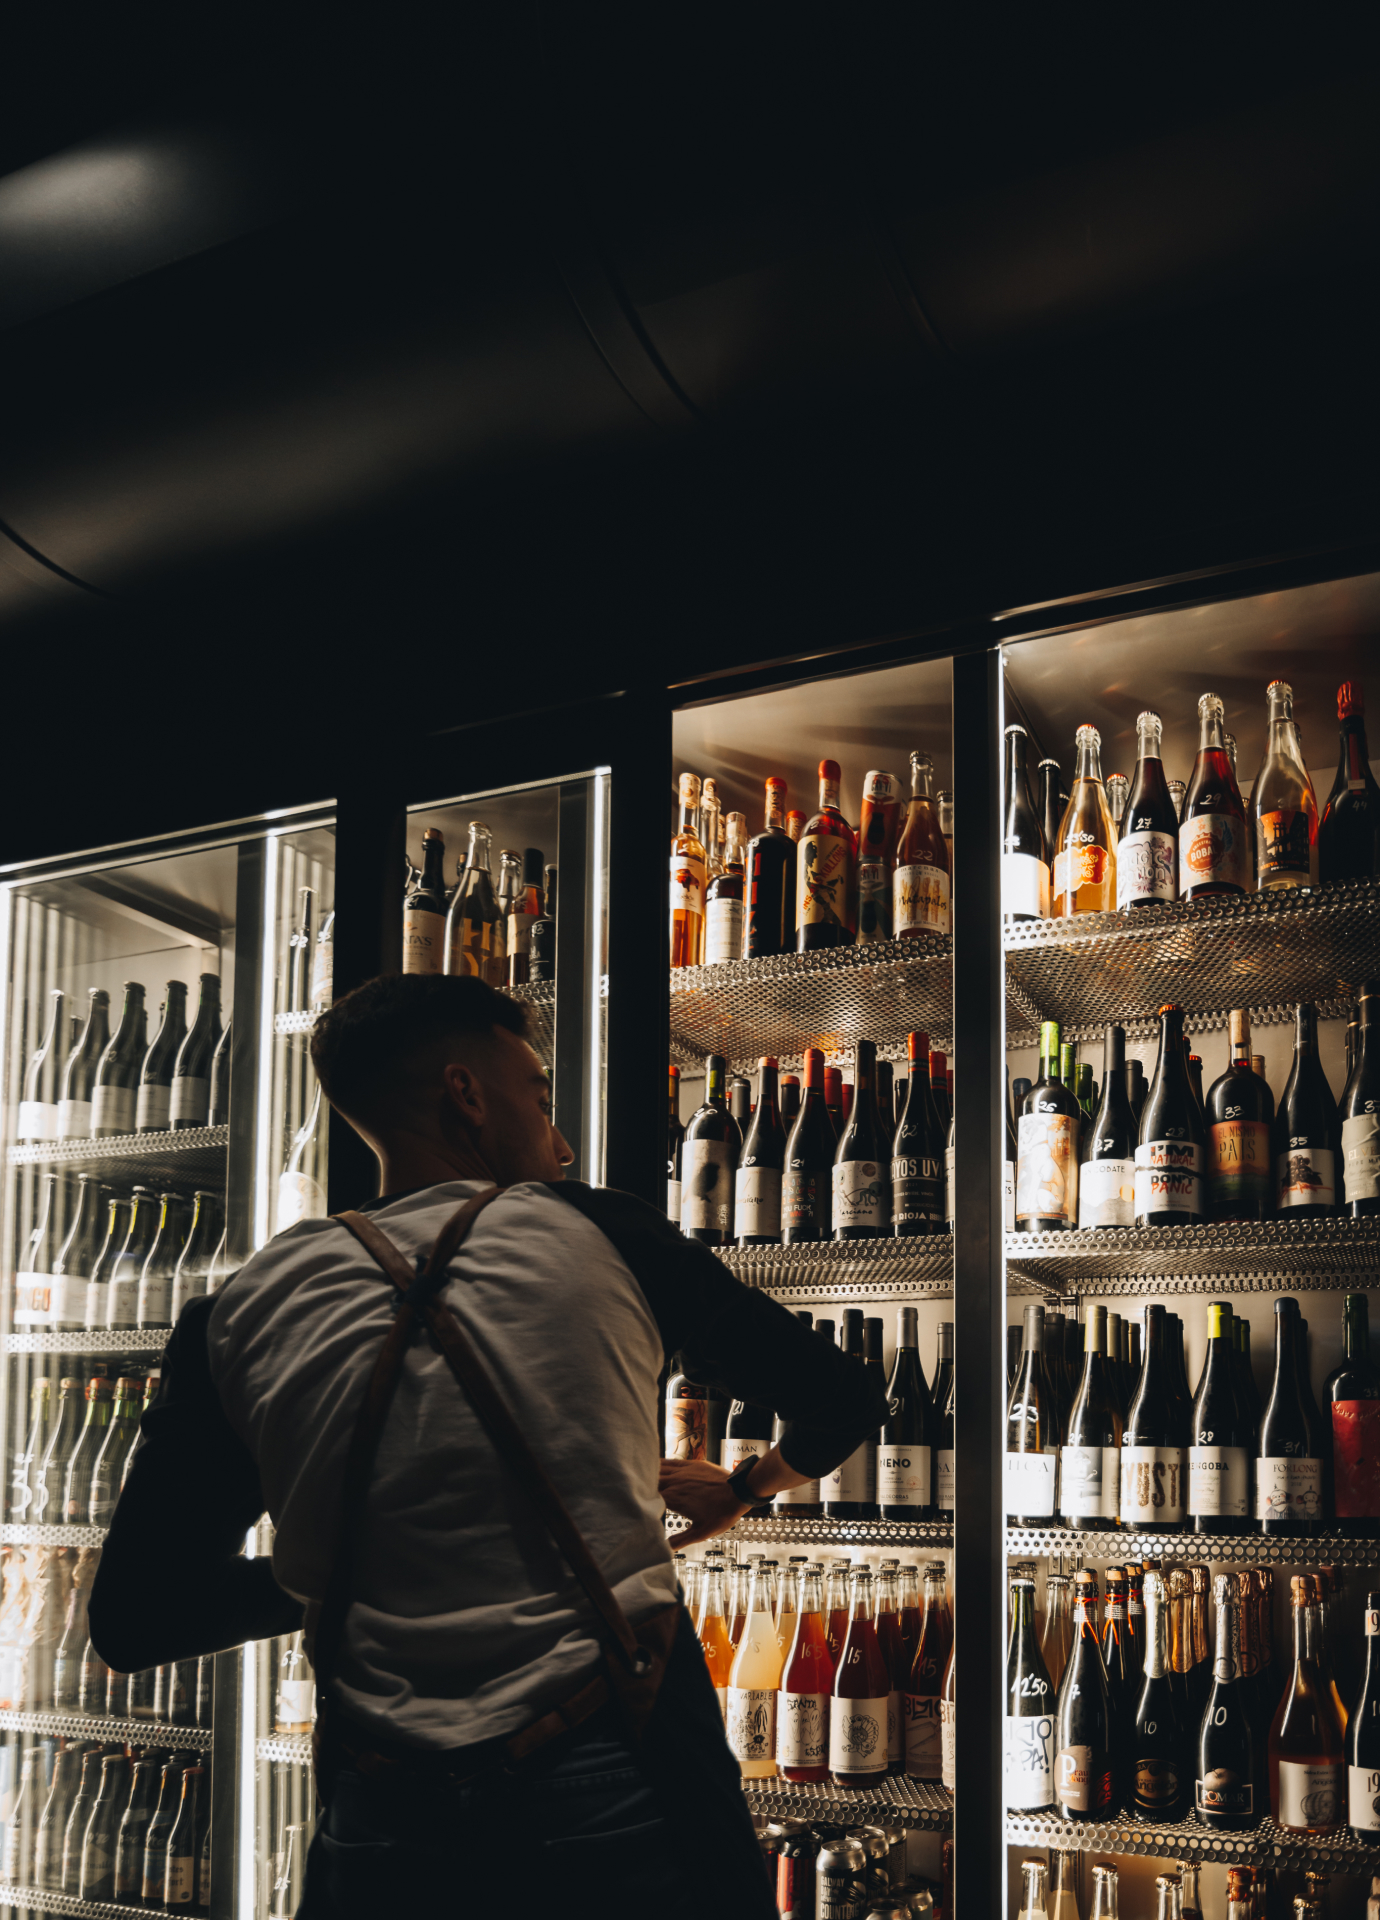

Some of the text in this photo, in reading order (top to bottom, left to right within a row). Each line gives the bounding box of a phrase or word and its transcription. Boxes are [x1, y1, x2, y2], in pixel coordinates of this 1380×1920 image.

[1135, 817, 1152, 830] 27
[1290, 1136, 1308, 1147] 35
[1150, 1145, 1194, 1157] I'M
[1150, 1154, 1195, 1166] NATURAL
[1151, 1182, 1193, 1194] PANIC
[898, 1212, 927, 1220] RIOJA
[1009, 1403, 1039, 1423] 23
[1199, 1431, 1214, 1444] 28
[1273, 1464, 1318, 1473] FORLONG
[281, 1649, 303, 1667] 65
[847, 1646, 862, 1664] 15
[1010, 1673, 1048, 1698] 12'50
[740, 1692, 773, 1701] VARIABLE
[1209, 1706, 1227, 1726] 10
[1144, 1720, 1157, 1735] 10
[820, 1876, 845, 1887] GALWAY
